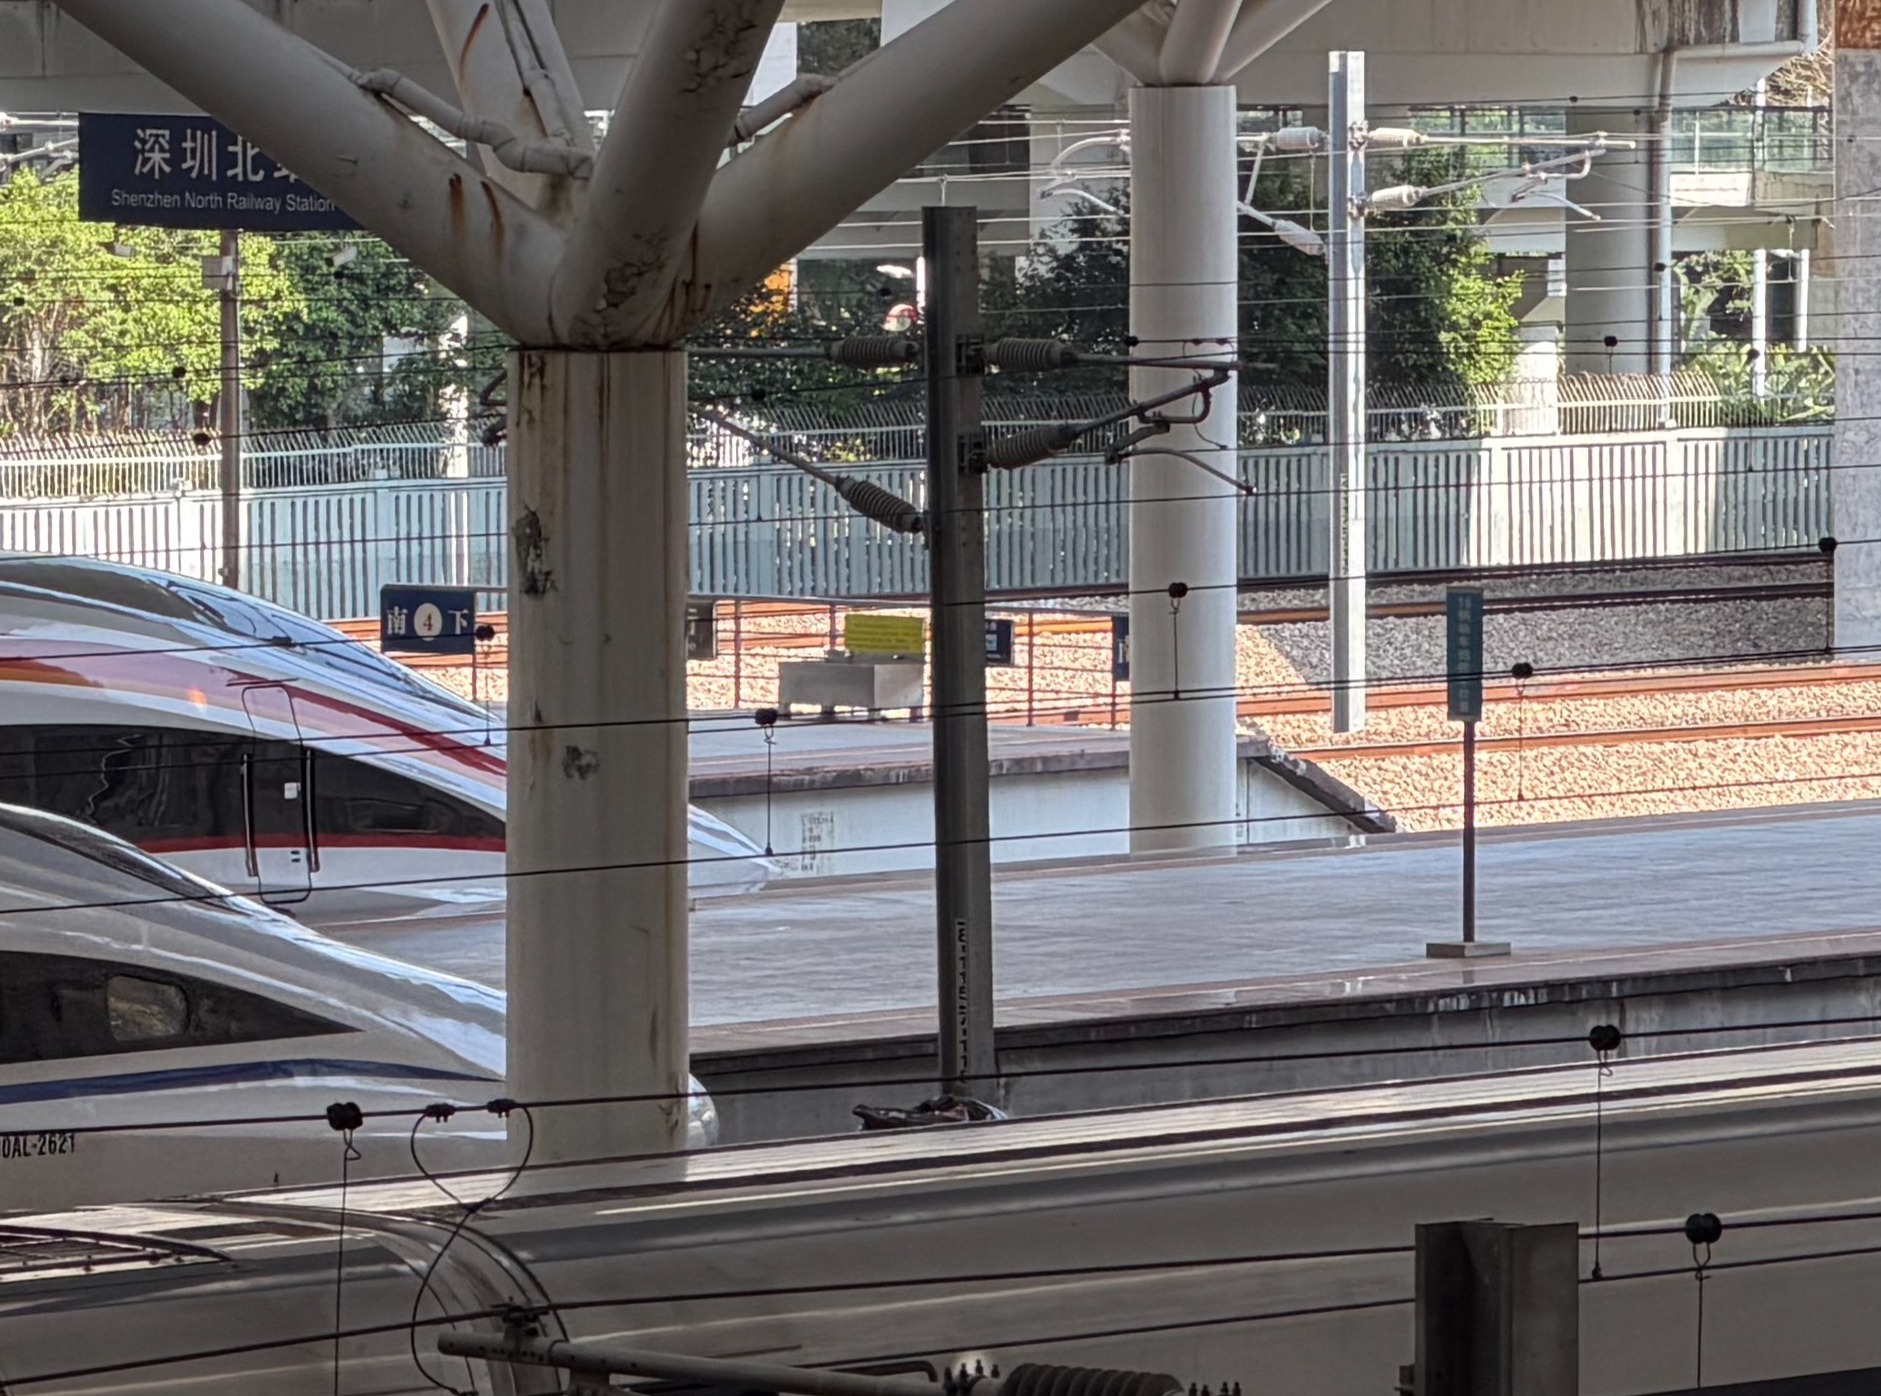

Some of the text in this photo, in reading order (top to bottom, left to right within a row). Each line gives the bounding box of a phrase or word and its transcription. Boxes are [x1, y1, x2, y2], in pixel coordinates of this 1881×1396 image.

[133, 128, 298, 183] 深圳北
[111, 189, 335, 214] Shenzhen North Railway Station
[386, 606, 469, 635] 南 4 下
